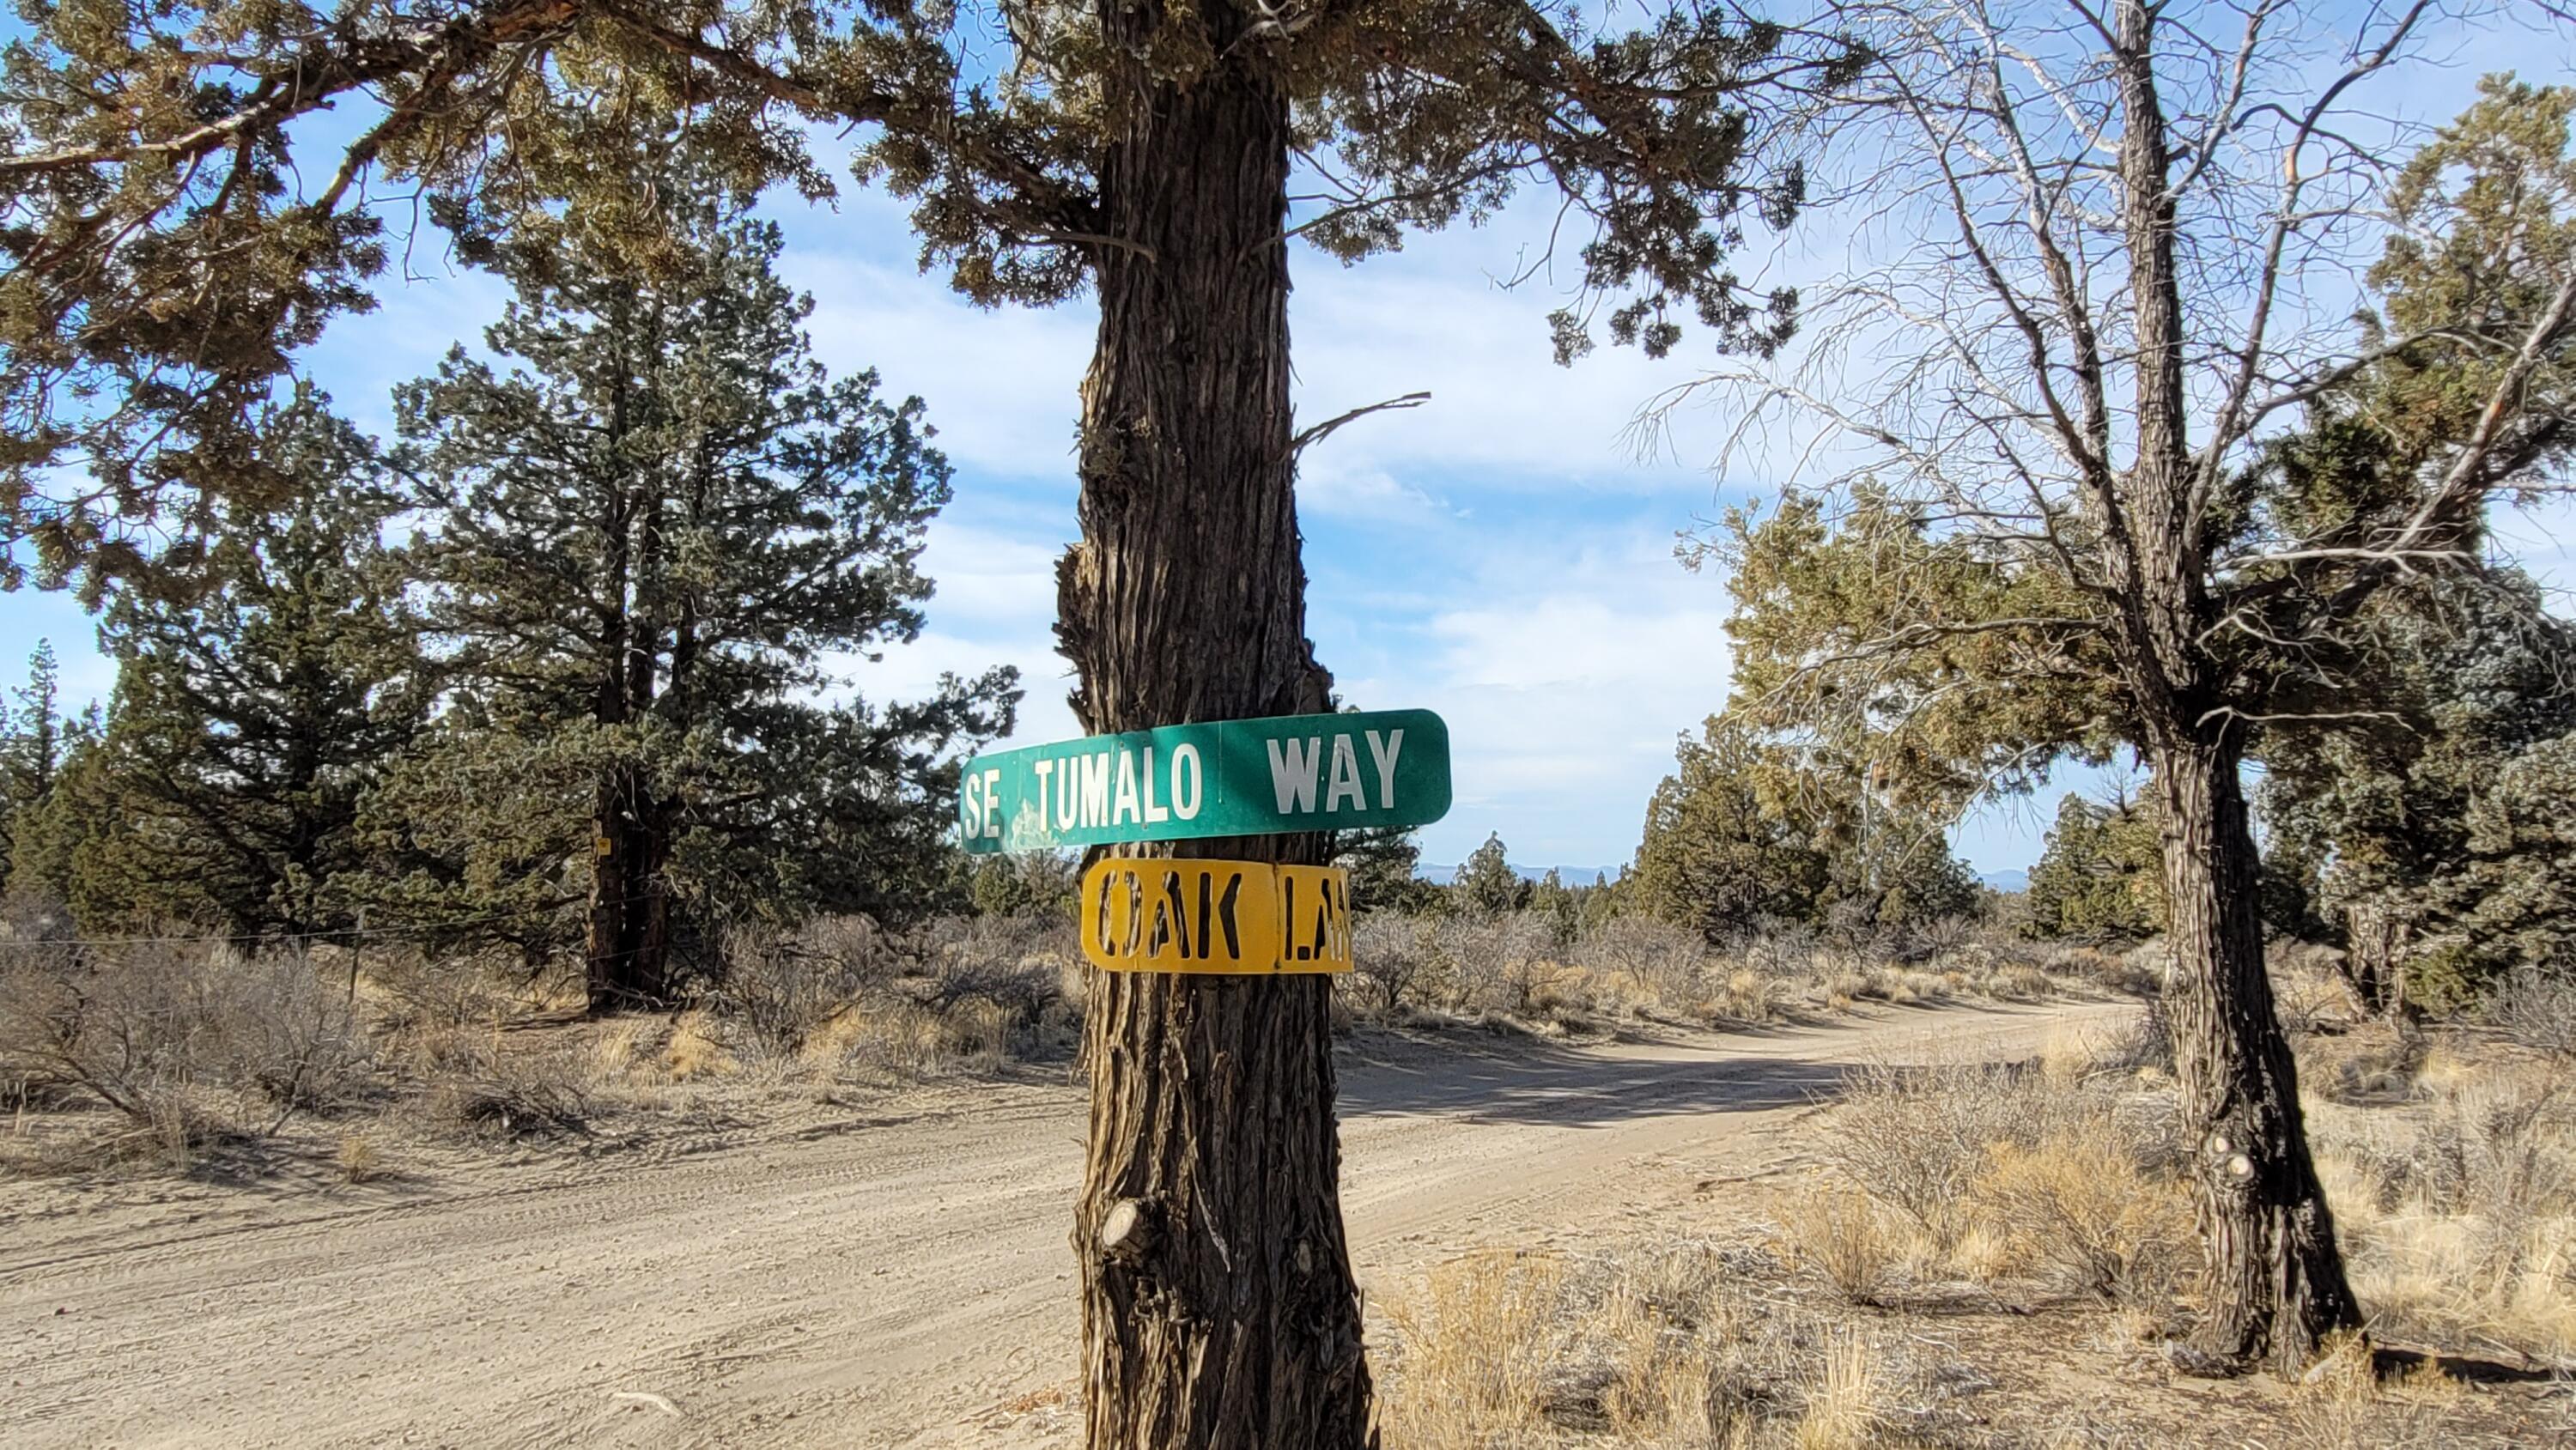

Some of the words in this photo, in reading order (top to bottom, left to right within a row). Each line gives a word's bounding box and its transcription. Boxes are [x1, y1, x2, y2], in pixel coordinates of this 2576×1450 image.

[964, 768, 1000, 840] SE
[1034, 743, 1202, 833] TUMALO
[1267, 728, 1405, 815] WAY
[1098, 870, 1242, 959] OAK
